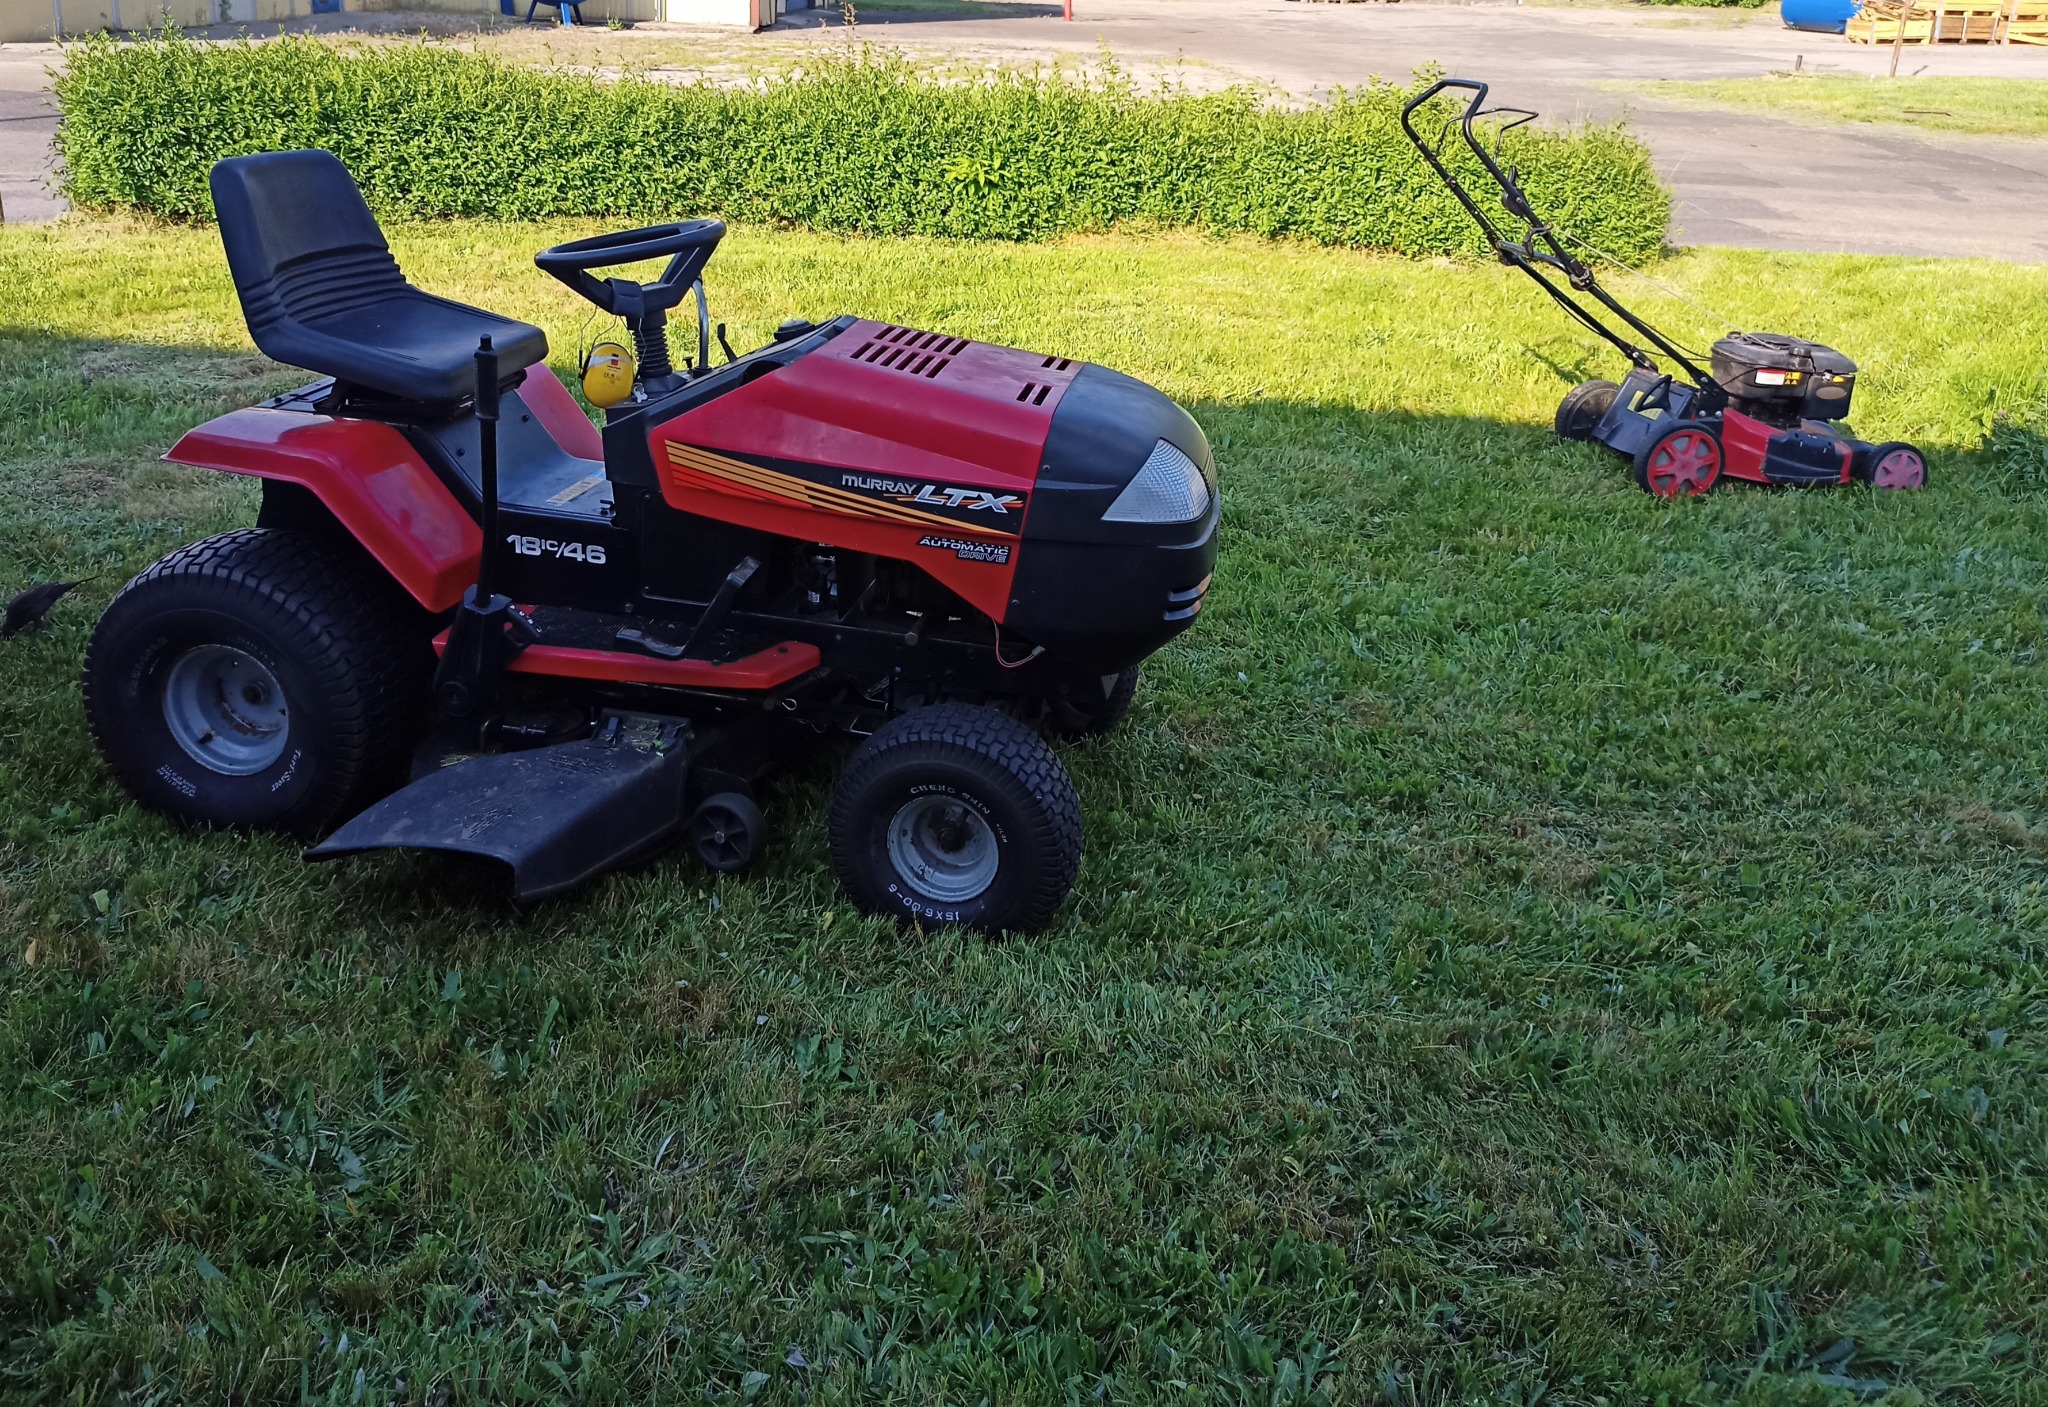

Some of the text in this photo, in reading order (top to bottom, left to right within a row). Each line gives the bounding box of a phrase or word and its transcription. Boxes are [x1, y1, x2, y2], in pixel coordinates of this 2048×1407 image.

[842, 474, 1018, 514] MURRAY LTX
[919, 538, 1009, 556] AUTOMATIC
[957, 550, 1007, 563] DRIVE
[910, 784, 956, 794] CHENG
